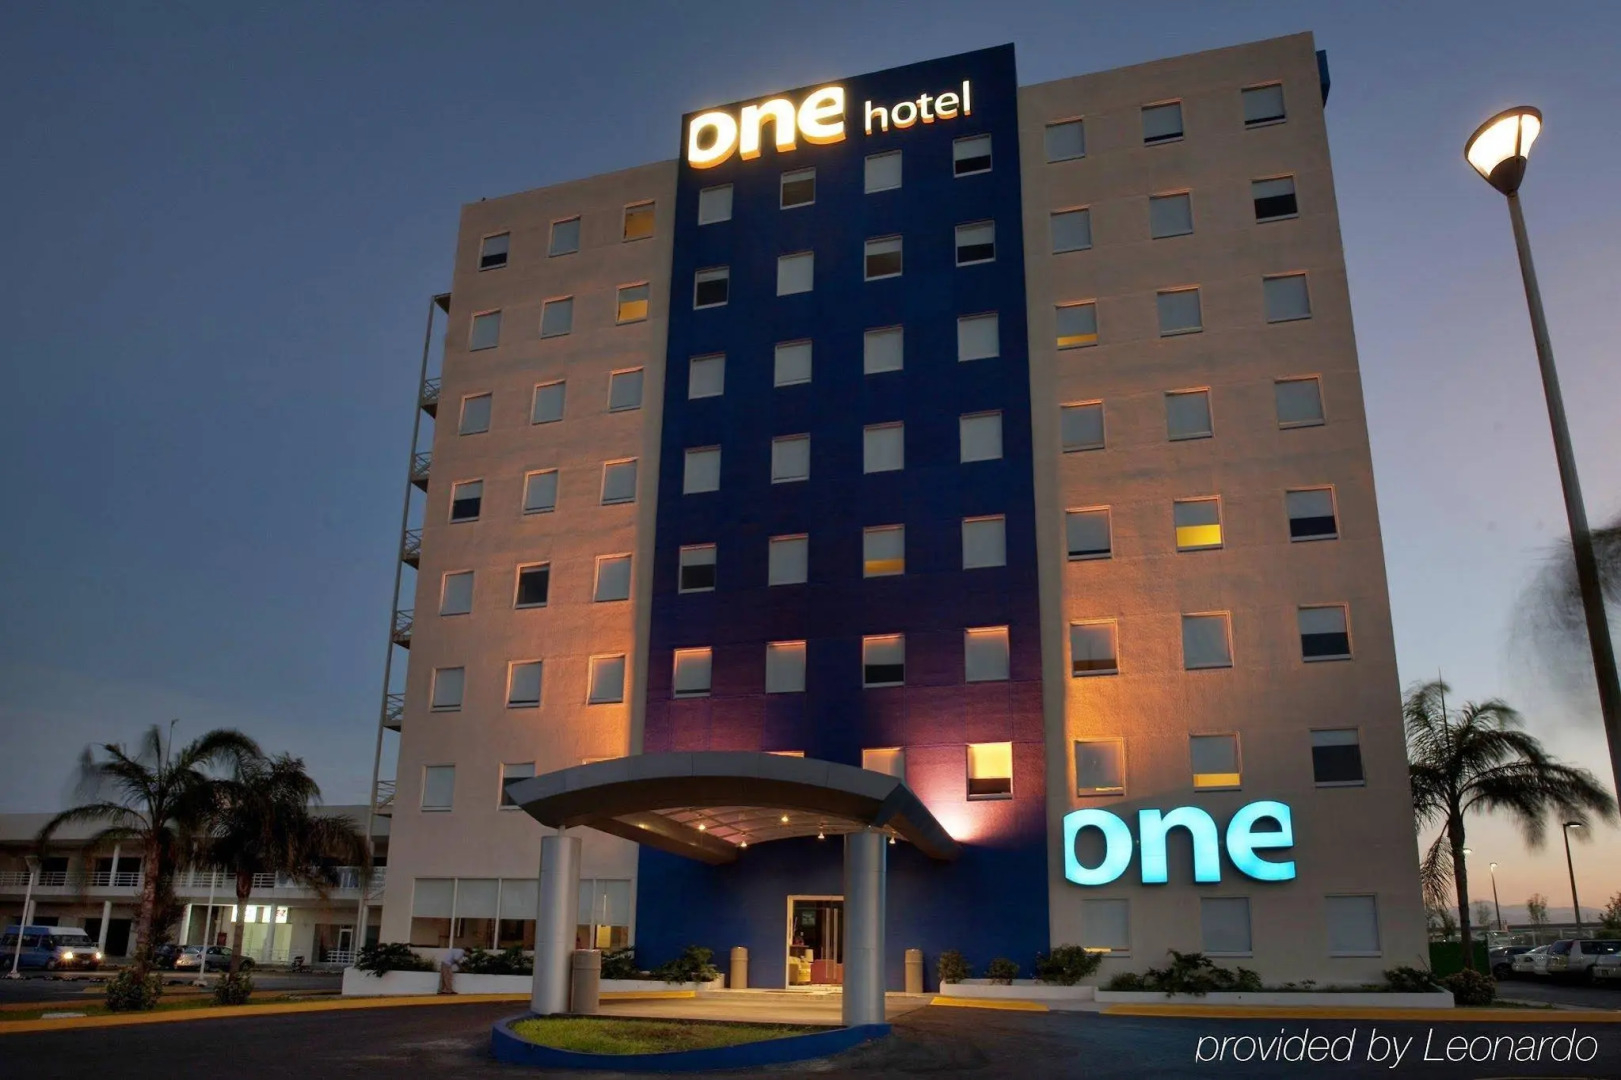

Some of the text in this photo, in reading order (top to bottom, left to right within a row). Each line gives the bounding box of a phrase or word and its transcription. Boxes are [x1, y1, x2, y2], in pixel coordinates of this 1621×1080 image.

[687, 80, 972, 169] one hotel
[1063, 800, 1296, 886] one
